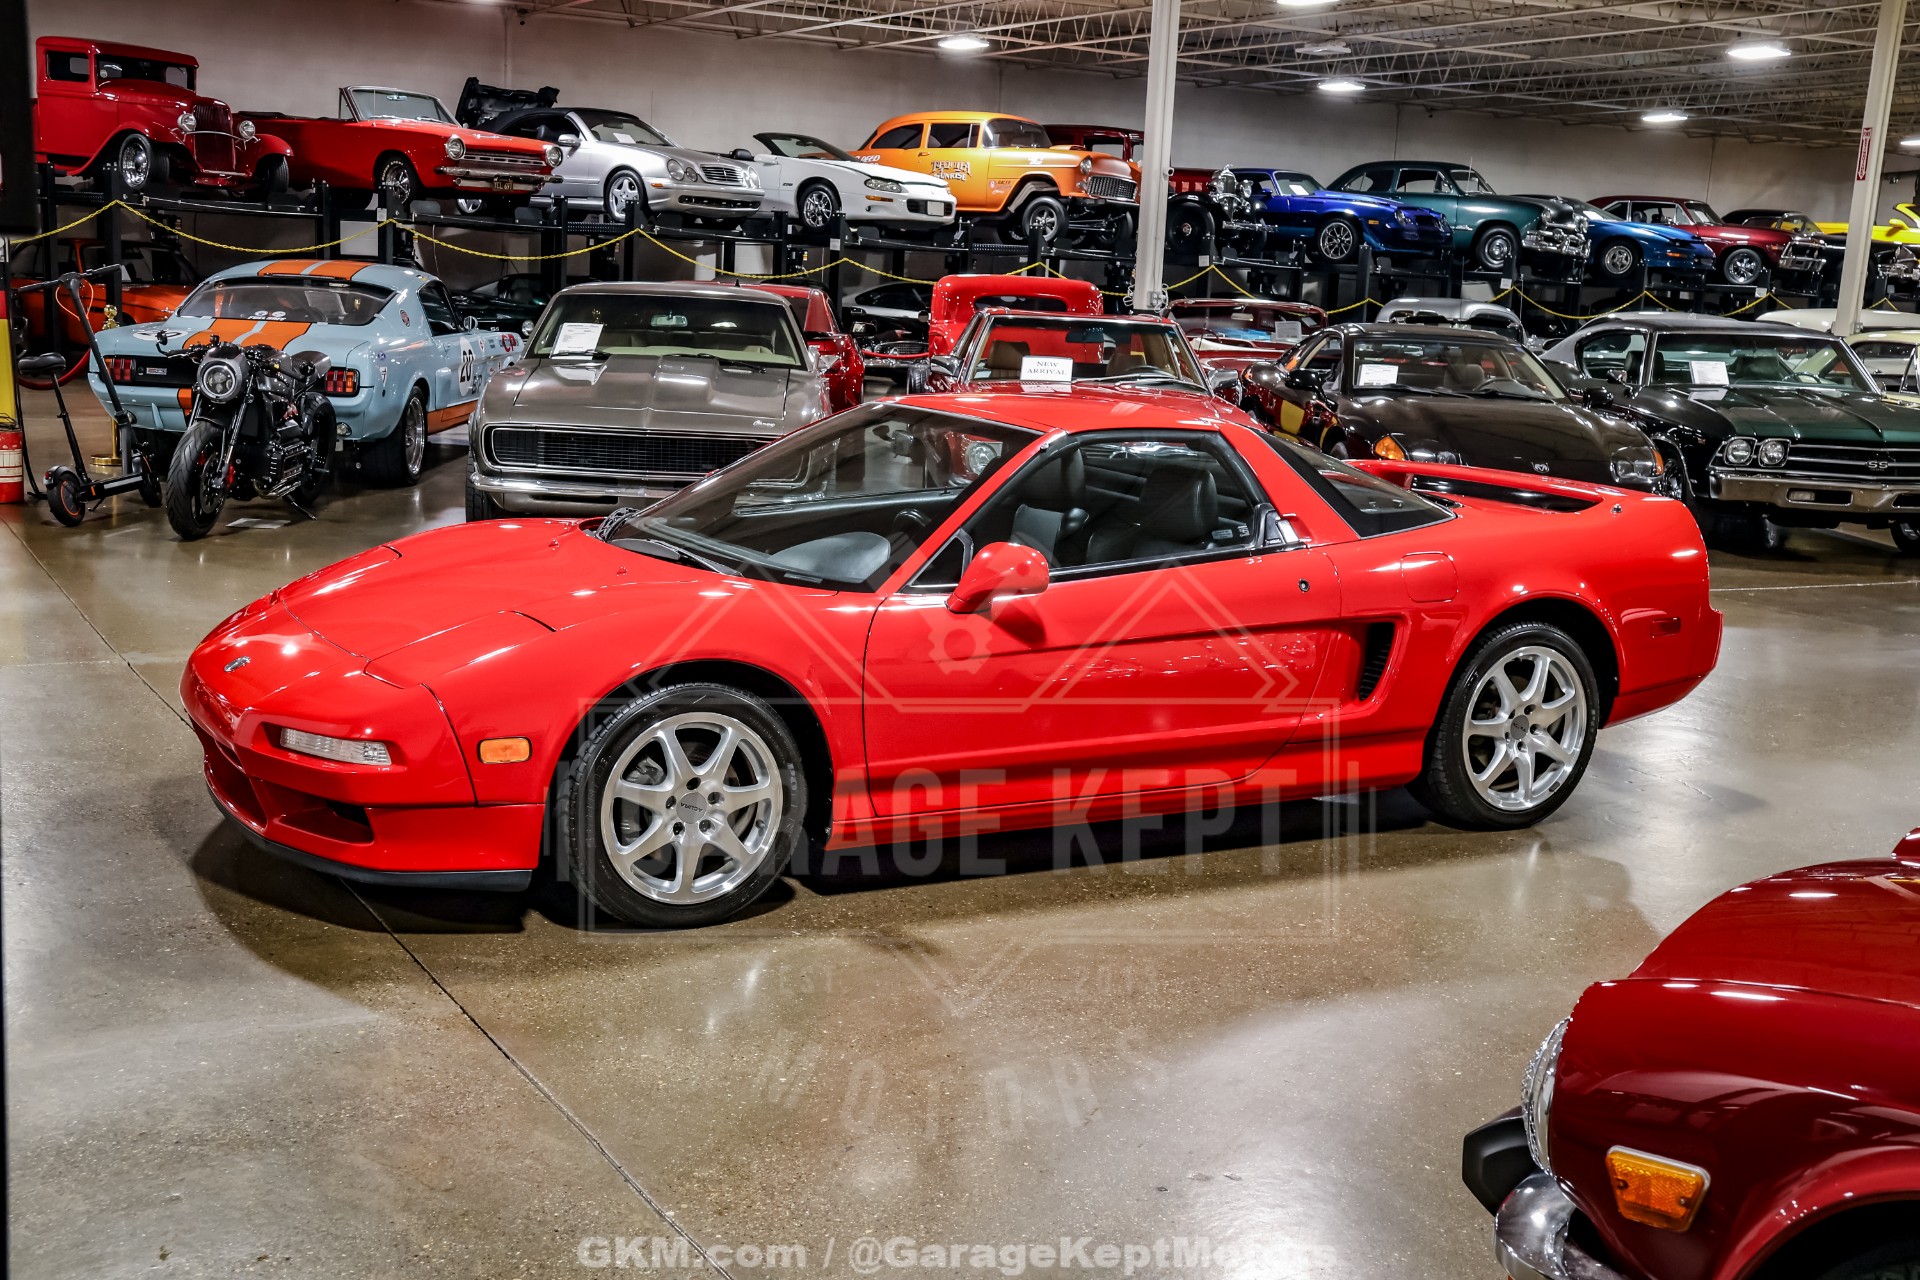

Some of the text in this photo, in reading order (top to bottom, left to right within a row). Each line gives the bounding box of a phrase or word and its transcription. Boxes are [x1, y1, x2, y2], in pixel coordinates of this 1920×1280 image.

[460, 349, 474, 383] 20
[1027, 368, 1067, 376] ARRIVAL
[1868, 460, 1889, 469] SS
[680, 802, 704, 812] ACURA
